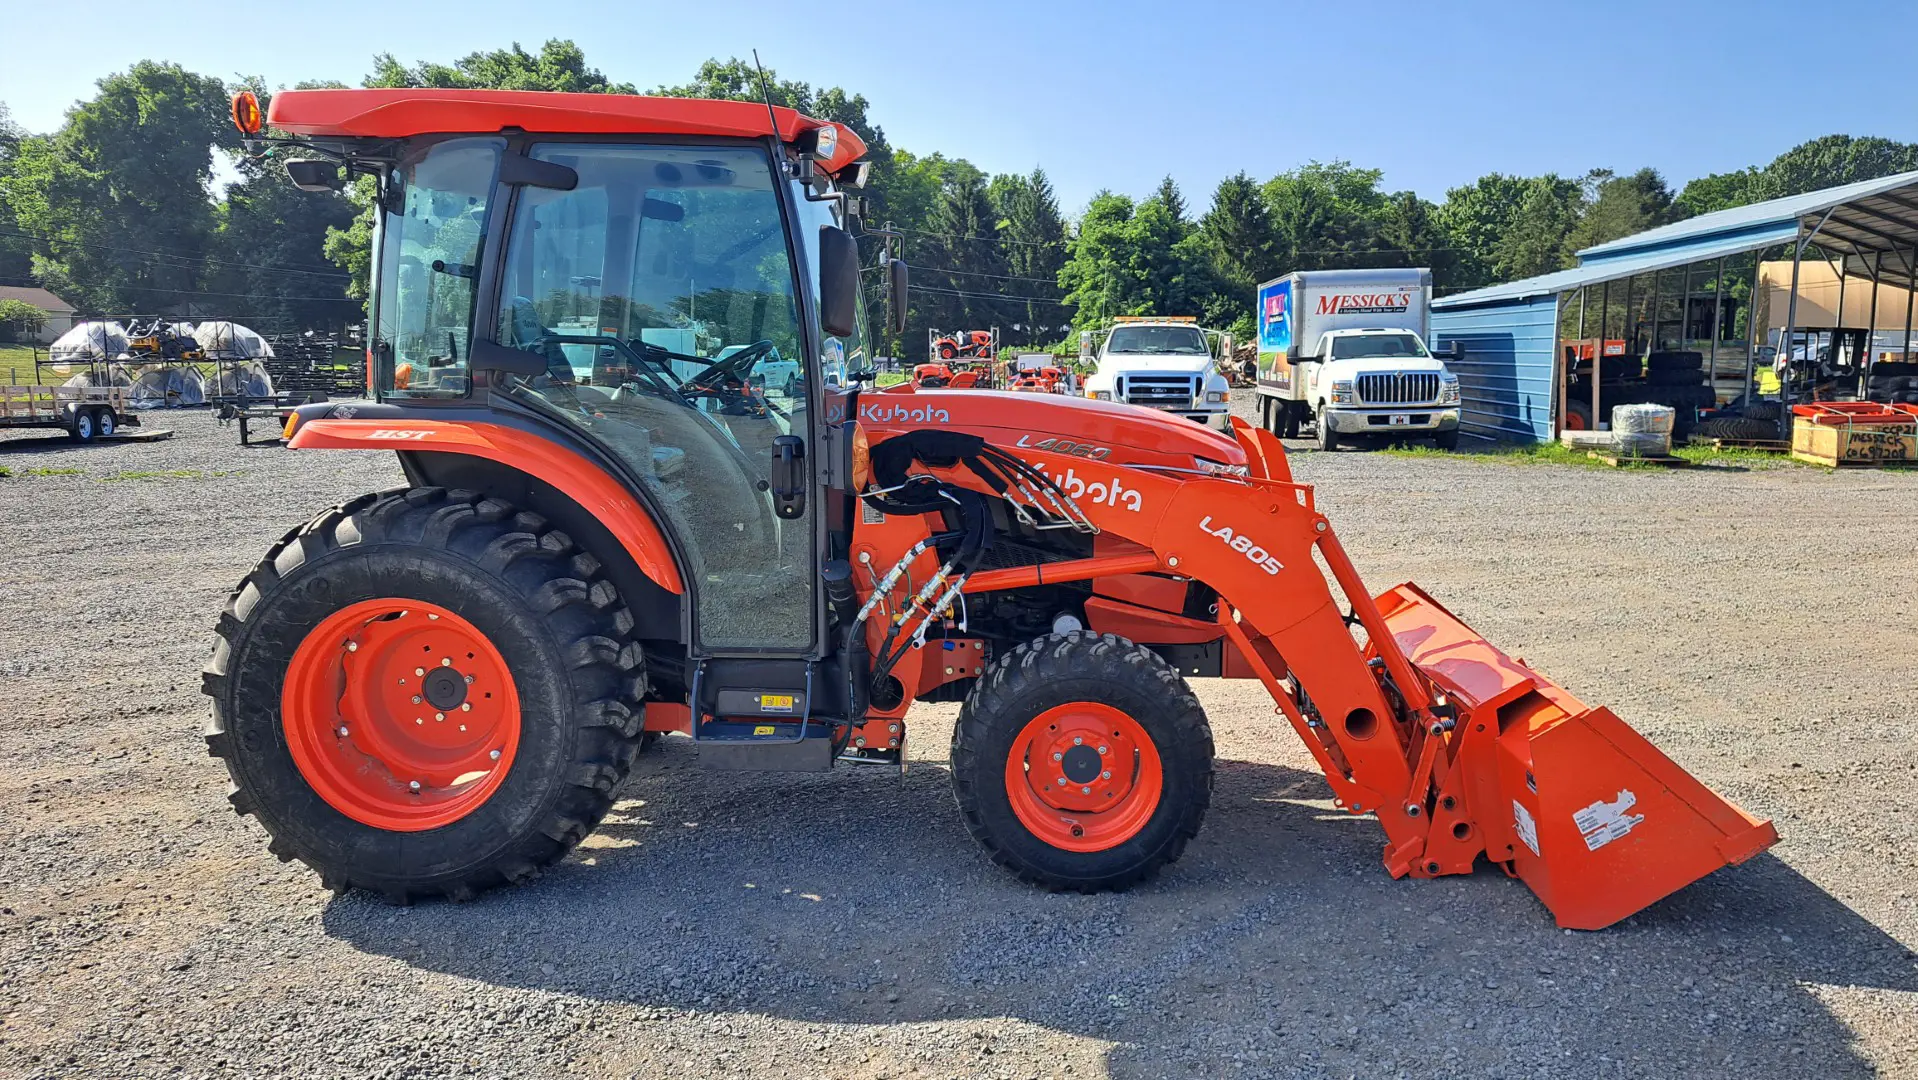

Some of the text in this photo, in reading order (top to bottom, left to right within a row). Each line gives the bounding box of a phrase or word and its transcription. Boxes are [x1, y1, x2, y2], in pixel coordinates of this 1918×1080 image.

[1315, 293, 1410, 315] MESSICK'S
[860, 403, 949, 423] Kubota
[366, 429, 436, 440] HST
[1199, 515, 1285, 575] LA805
